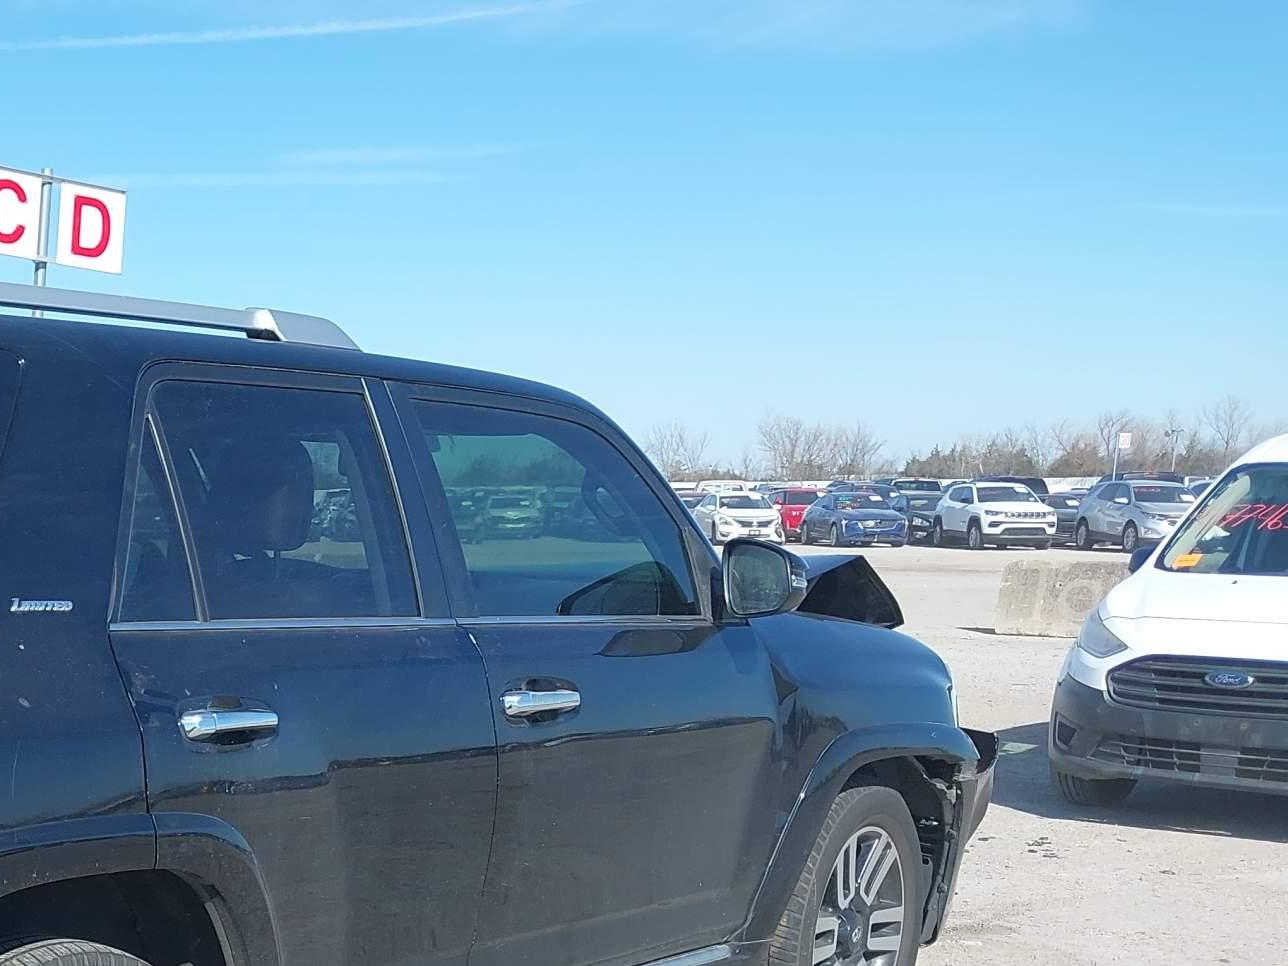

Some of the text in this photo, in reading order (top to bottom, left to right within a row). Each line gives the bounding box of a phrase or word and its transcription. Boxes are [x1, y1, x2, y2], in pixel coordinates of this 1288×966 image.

[71, 194, 111, 258] D
[1218, 503, 1288, 530] 7746
[1215, 673, 1242, 685] Ford
